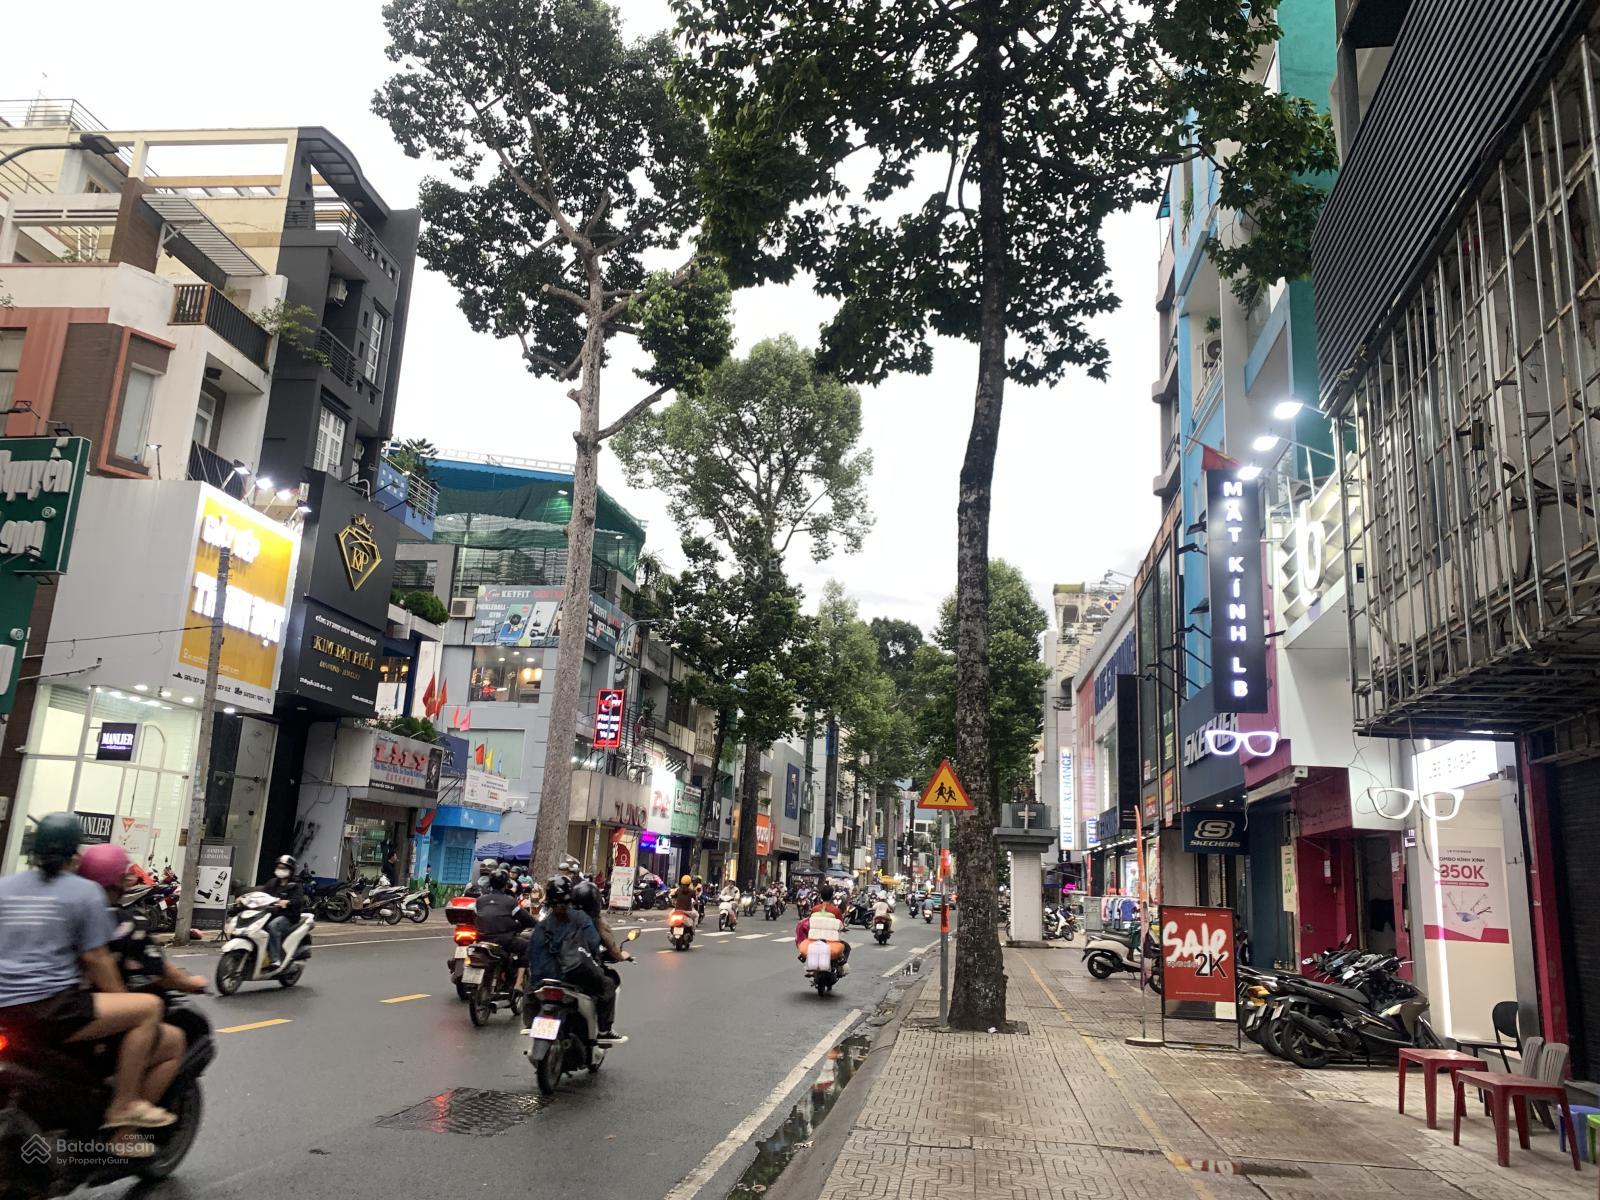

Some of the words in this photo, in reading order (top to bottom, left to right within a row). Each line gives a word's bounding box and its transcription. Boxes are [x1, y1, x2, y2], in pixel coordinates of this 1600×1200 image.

[501, 590, 531, 599] KETFIT
[1228, 556, 1247, 642] KÍNH
[313, 635, 334, 655] KIM
[1232, 656, 1249, 698] LB
[101, 733, 134, 746] MANLIER
[1183, 712, 1240, 768] SKECHER
[614, 800, 647, 827] JUNO
[1189, 840, 1241, 848] SKECHERS
[1439, 864, 1485, 880] 350K
[1195, 953, 1228, 978] 2K
